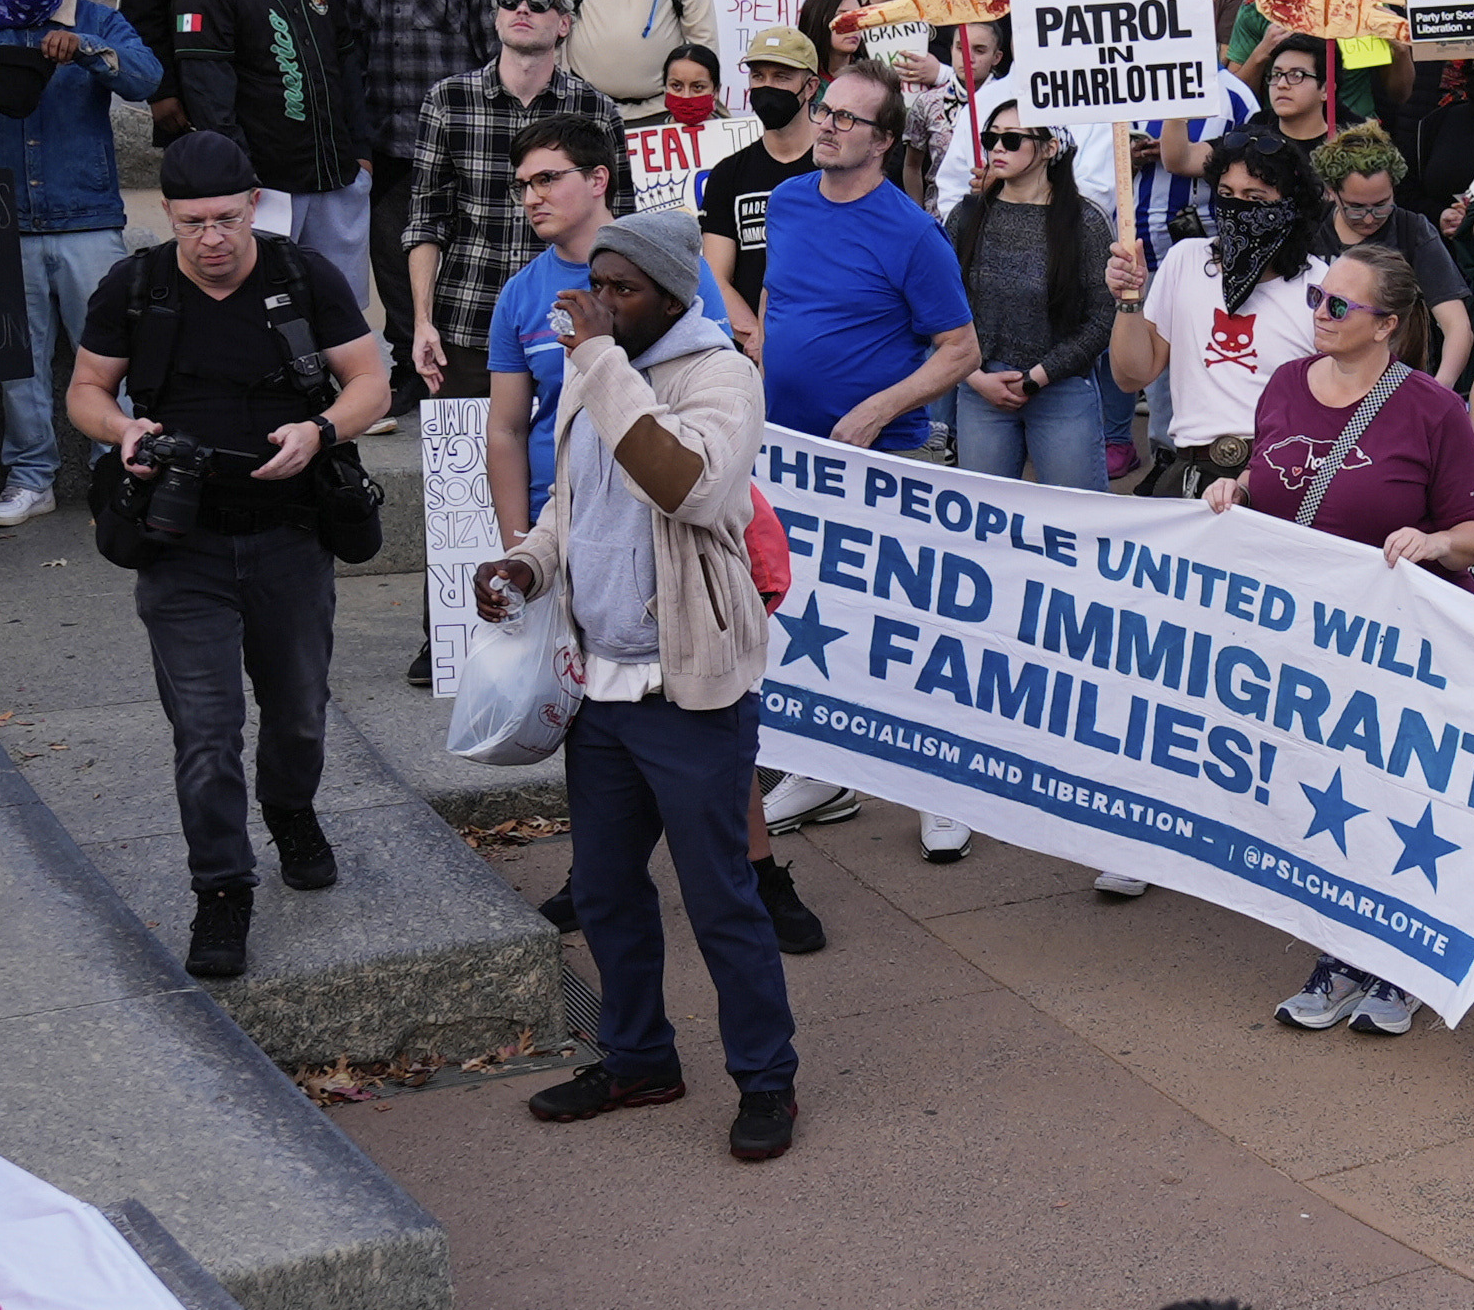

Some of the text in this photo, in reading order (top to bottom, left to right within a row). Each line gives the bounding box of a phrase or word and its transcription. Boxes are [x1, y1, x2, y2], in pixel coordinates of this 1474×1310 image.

[1036, 0, 1192, 48] PATROL
[1416, 11, 1440, 24] Party
[1441, 10, 1455, 21] for
[1416, 21, 1463, 34] Liberation
[270, 9, 305, 121] mexico
[1099, 45, 1134, 64] IN
[1030, 61, 1205, 109] CHARLOTTE!
[864, 466, 1447, 690] PEOPLE UNITED WILL
[869, 614, 1278, 806] FAMILIES!
[812, 703, 1450, 956] SOCIALISM AND LIBERATION @PSLCHARLOTTE
